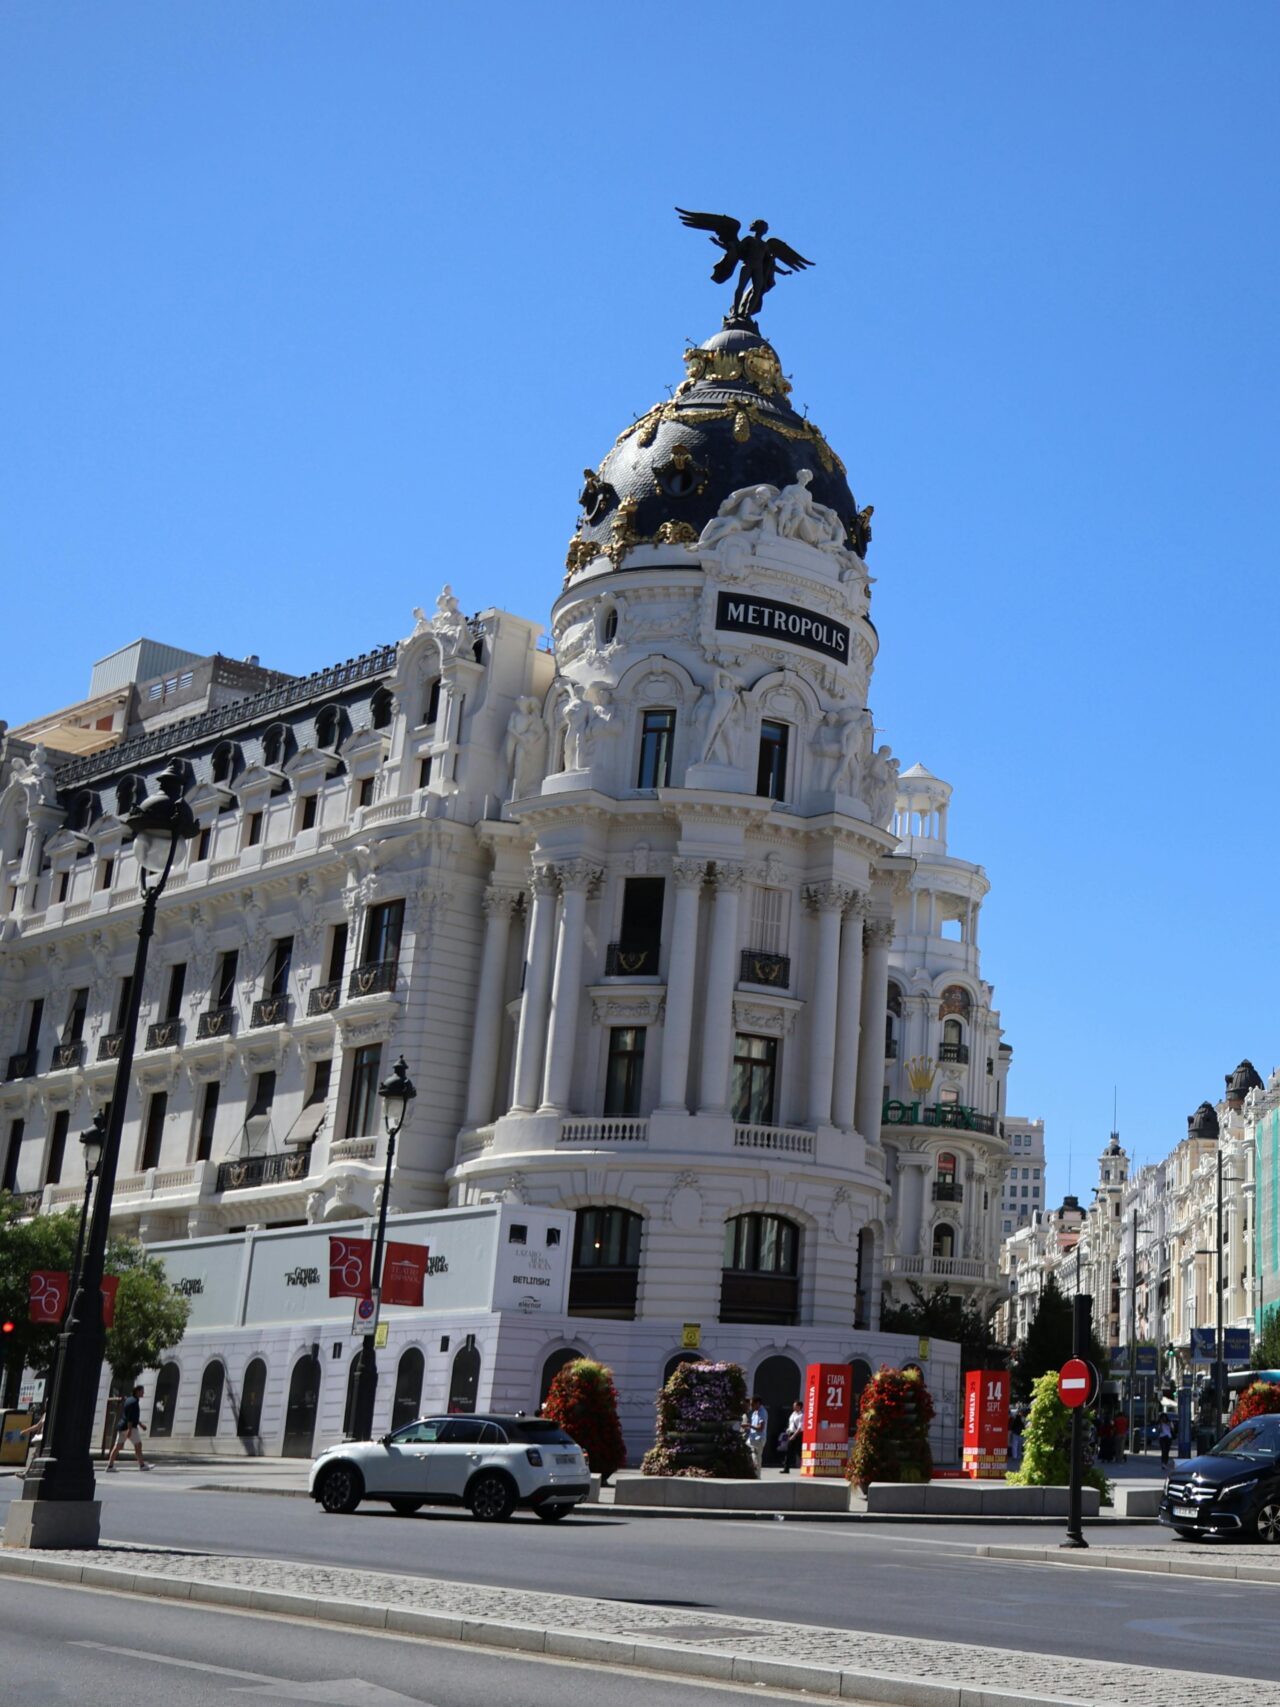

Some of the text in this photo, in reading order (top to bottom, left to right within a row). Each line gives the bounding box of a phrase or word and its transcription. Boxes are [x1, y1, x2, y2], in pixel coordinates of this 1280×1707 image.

[727, 602, 846, 651] METROPOLIS
[883, 1100, 978, 1129] OLEX
[285, 1273, 320, 1287] Paraguas
[295, 1267, 319, 1278] Grupo
[181, 1278, 202, 1290] Grupo
[827, 1374, 845, 1386] ETAPA
[826, 1387, 843, 1407] 21
[987, 1381, 1002, 1400] 14
